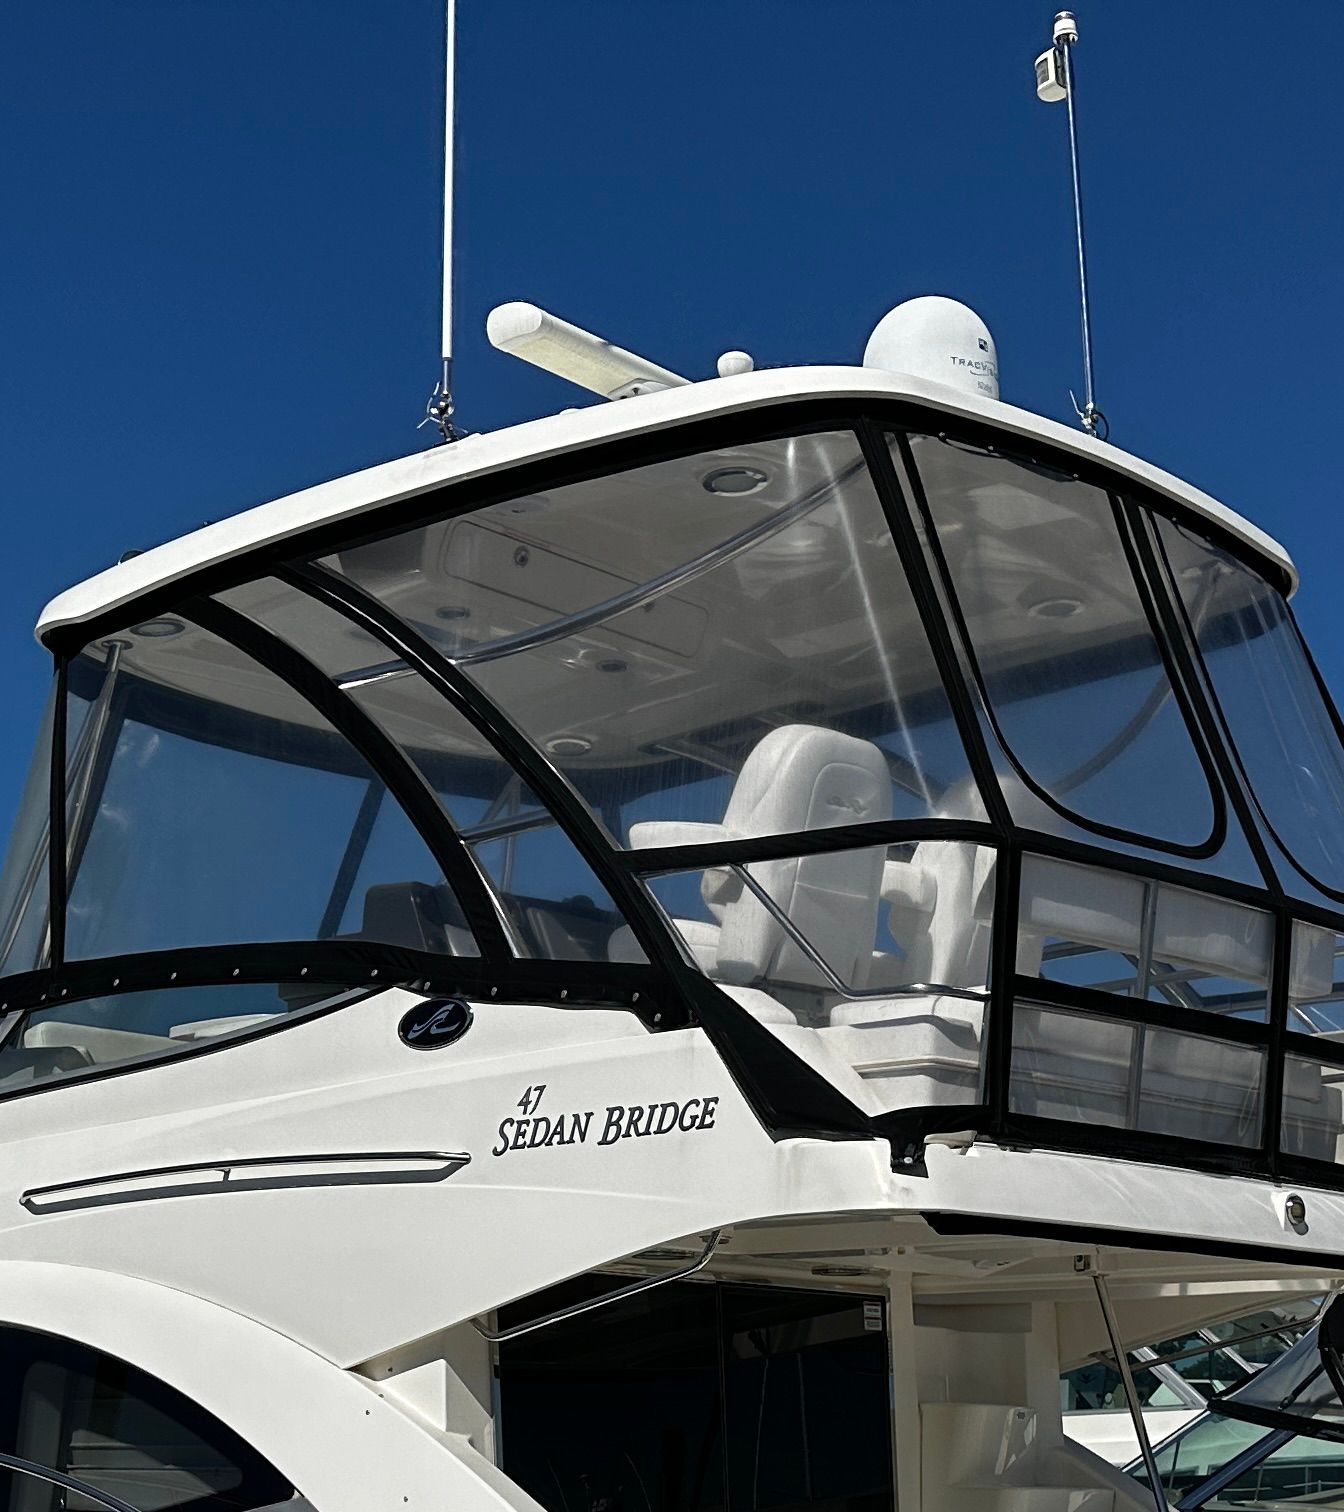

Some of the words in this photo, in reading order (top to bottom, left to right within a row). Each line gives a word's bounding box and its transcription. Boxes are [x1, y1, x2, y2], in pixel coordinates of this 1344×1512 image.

[517, 1085, 546, 1115] 47
[492, 1112, 594, 1156] SEDAN
[597, 1097, 719, 1146] BRIDGE
